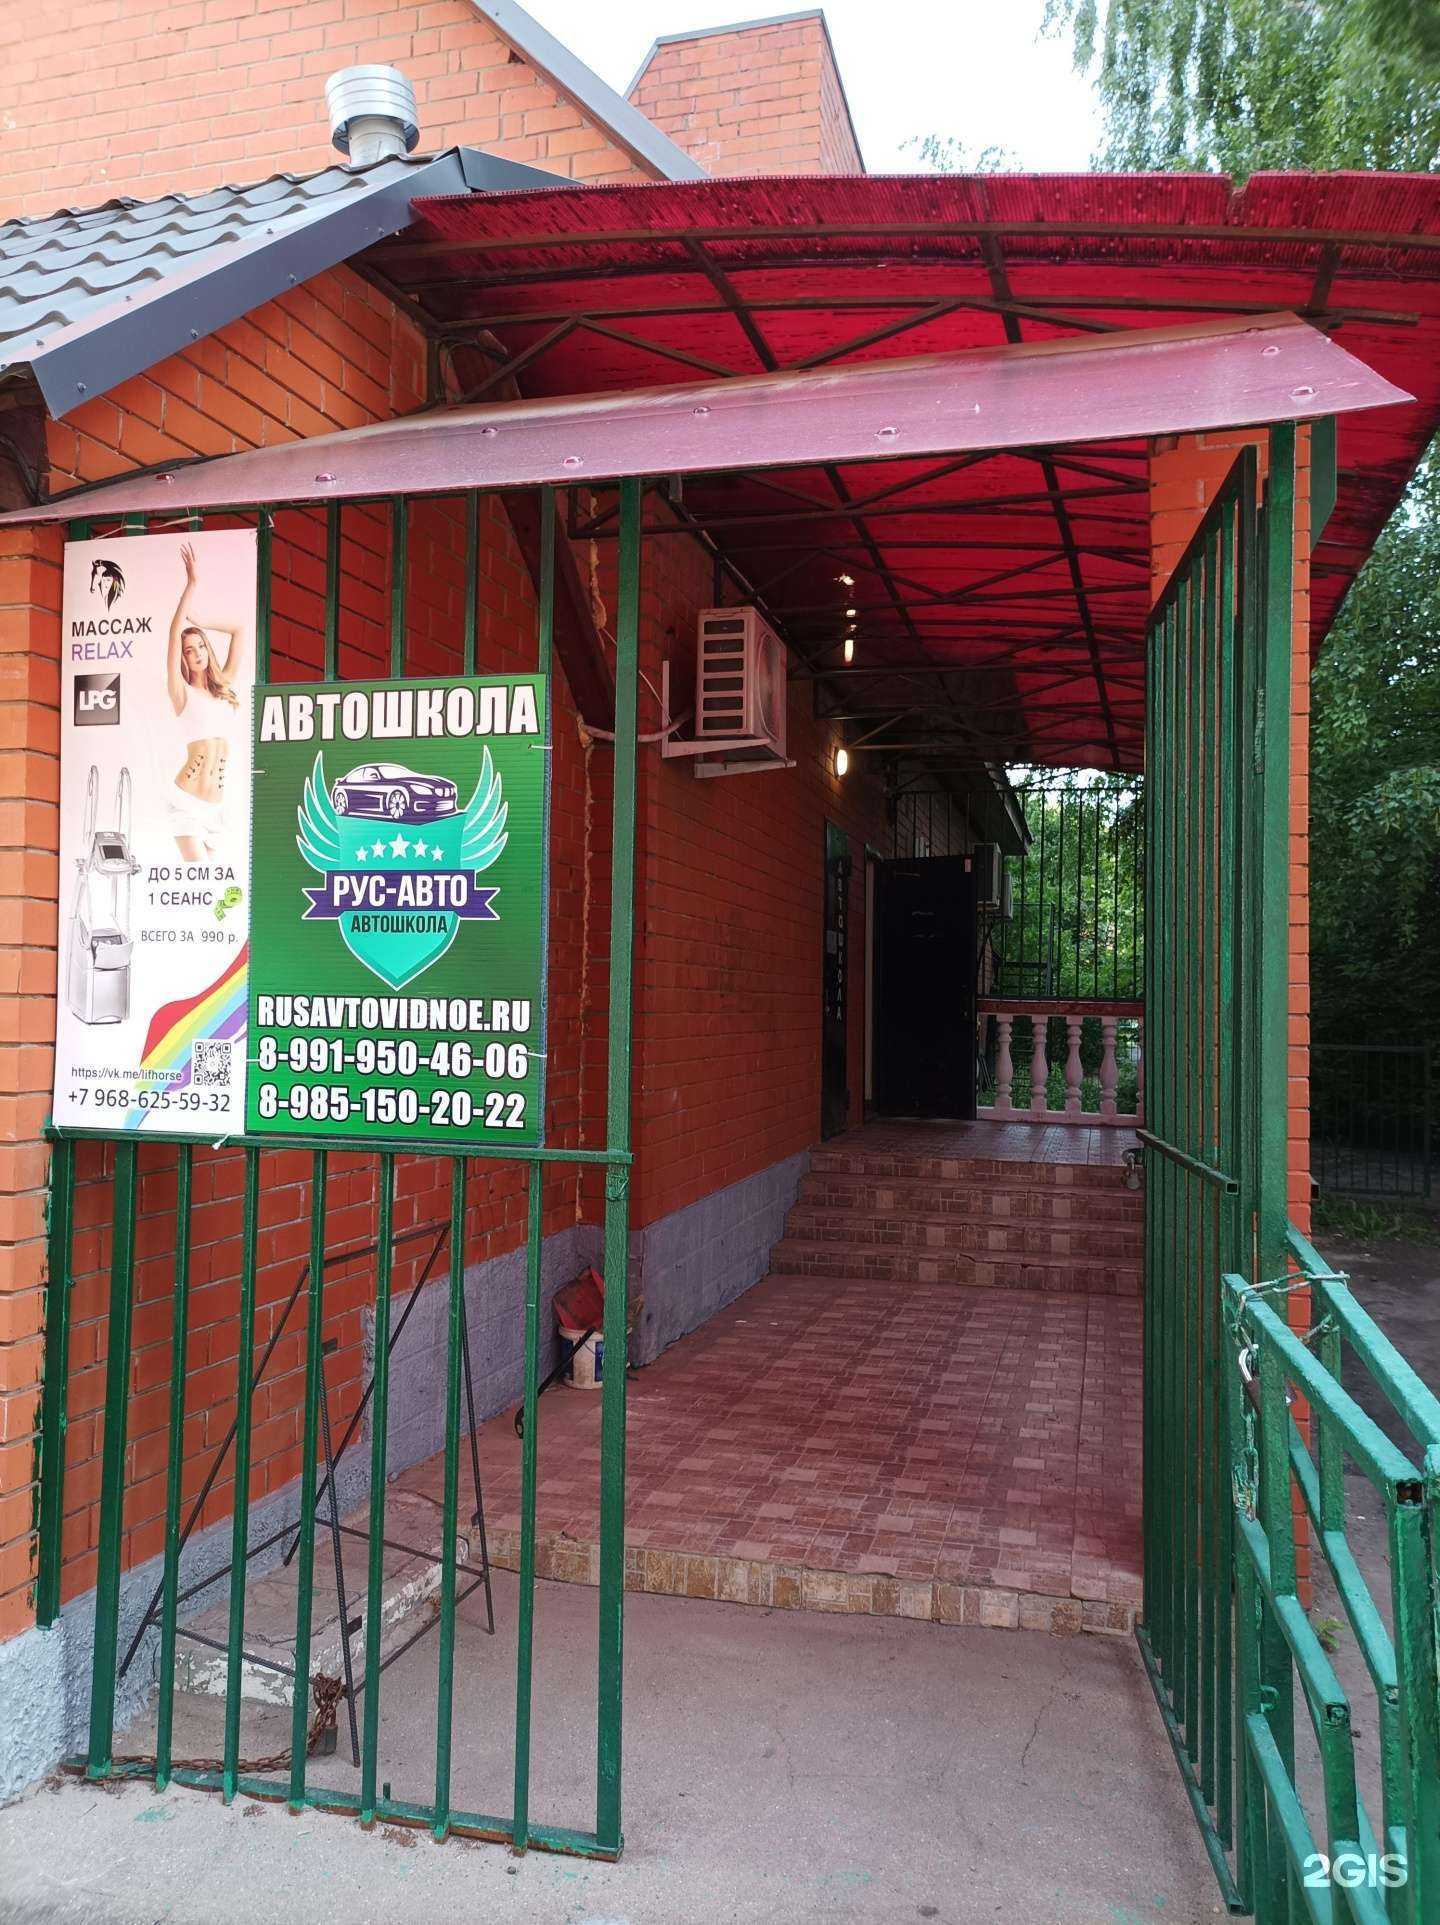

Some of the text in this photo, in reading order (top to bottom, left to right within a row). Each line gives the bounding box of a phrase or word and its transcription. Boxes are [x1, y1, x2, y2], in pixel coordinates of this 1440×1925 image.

[71, 616, 152, 638] МАССАЖ
[71, 640, 133, 662] RELAX
[79, 689, 117, 711] LPG
[259, 684, 540, 743] АВТОШКОЛА
[148, 867, 235, 883] ДО 5 СМ ЗА
[149, 891, 213, 906] 1 СЕАНС
[332, 874, 469, 908] РУС-АВТО
[350, 914, 448, 935] АВТОШКОЛА
[141, 930, 239, 945] ВСЕГО ЗА 990 р.
[257, 994, 532, 1033] RUSAVTOVIDNOE.RU
[258, 1036, 529, 1080] 8-991-950-46-06
[68, 1088, 230, 1112] +7 968-625-59-32
[258, 1083, 527, 1129] 8-985-150-20-22
